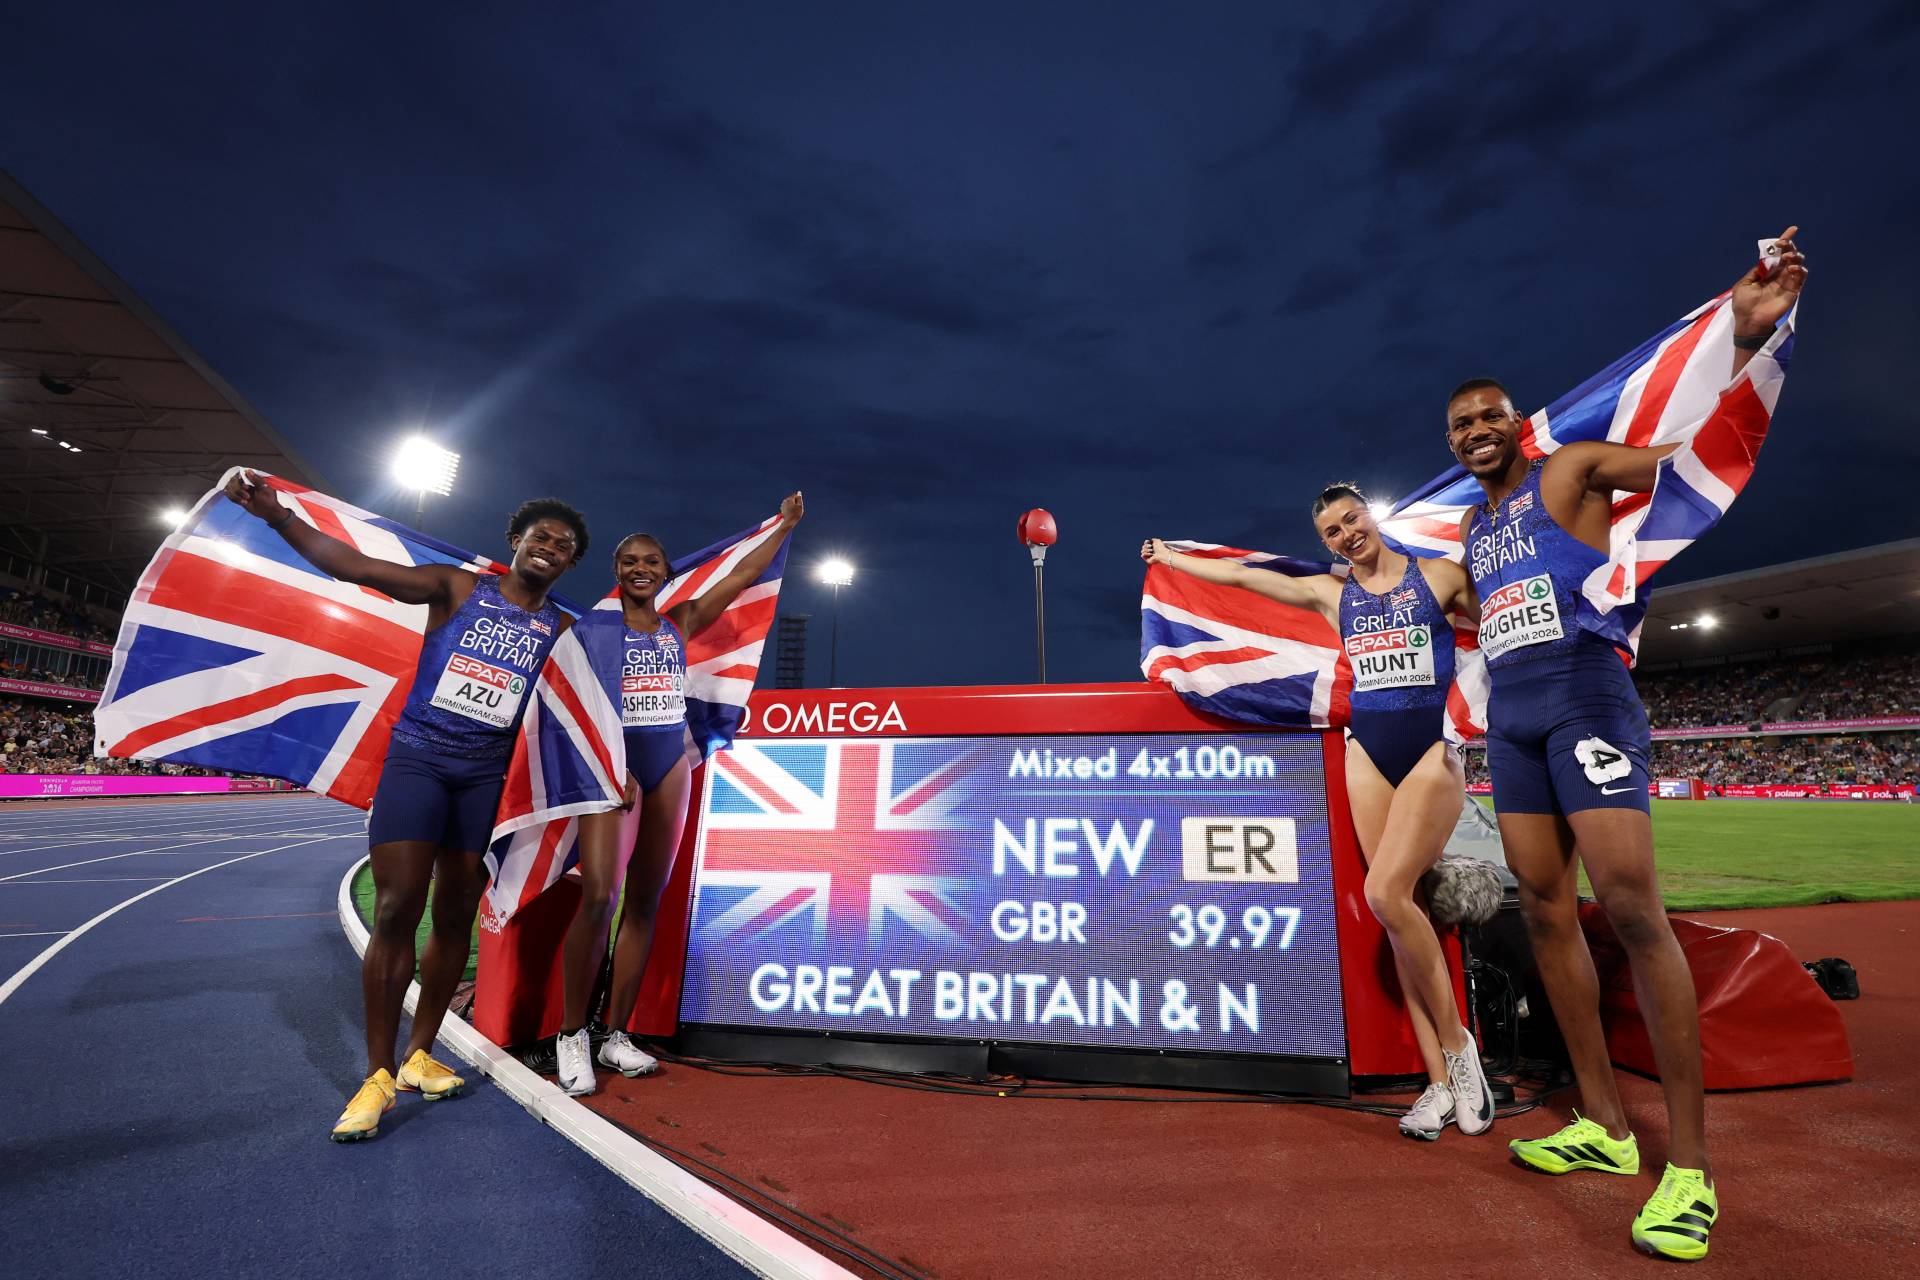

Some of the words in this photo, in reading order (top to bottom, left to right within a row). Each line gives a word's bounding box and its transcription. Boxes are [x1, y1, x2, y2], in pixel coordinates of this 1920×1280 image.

[1472, 518, 1523, 561] GREAT
[1472, 536, 1536, 583] BRITAIN
[1482, 587, 1523, 619] SPAR
[499, 616, 530, 634] Novuna
[1353, 607, 1415, 632] GREAT
[1479, 603, 1555, 645] HUGHES
[474, 618, 542, 653] GREAT
[1348, 633, 1406, 653] SPAR
[1532, 627, 1559, 640] 2026
[460, 630, 539, 673] BRITAIN
[626, 649, 680, 664] GREAT
[1359, 653, 1419, 676] HUNT
[450, 658, 511, 687] SPAR
[622, 664, 684, 676] BRITAIN
[1410, 673, 1431, 682] 2026
[456, 682, 502, 709] AZU
[623, 677, 673, 691] SPAR
[434, 695, 492, 720] BIRMINGHAM
[491, 714, 510, 727] 2026
[622, 695, 686, 712] ASHER-SMITH
[762, 700, 908, 734] OMEGA
[623, 714, 674, 724] BIRMINGHAM
[1008, 747, 1117, 779] Mixed
[1127, 745, 1277, 779] 4x100m
[1592, 750, 1622, 770] 4
[992, 817, 1155, 878] NEW
[1205, 825, 1277, 874] ER
[480, 914, 501, 936] OMEGA
[990, 899, 1088, 944] GBR
[1169, 903, 1302, 950] 39.97
[749, 962, 922, 1018] GREAT
[934, 970, 1141, 1028] BRITAIN
[1159, 979, 1200, 1032] &
[1217, 981, 1260, 1034] N
